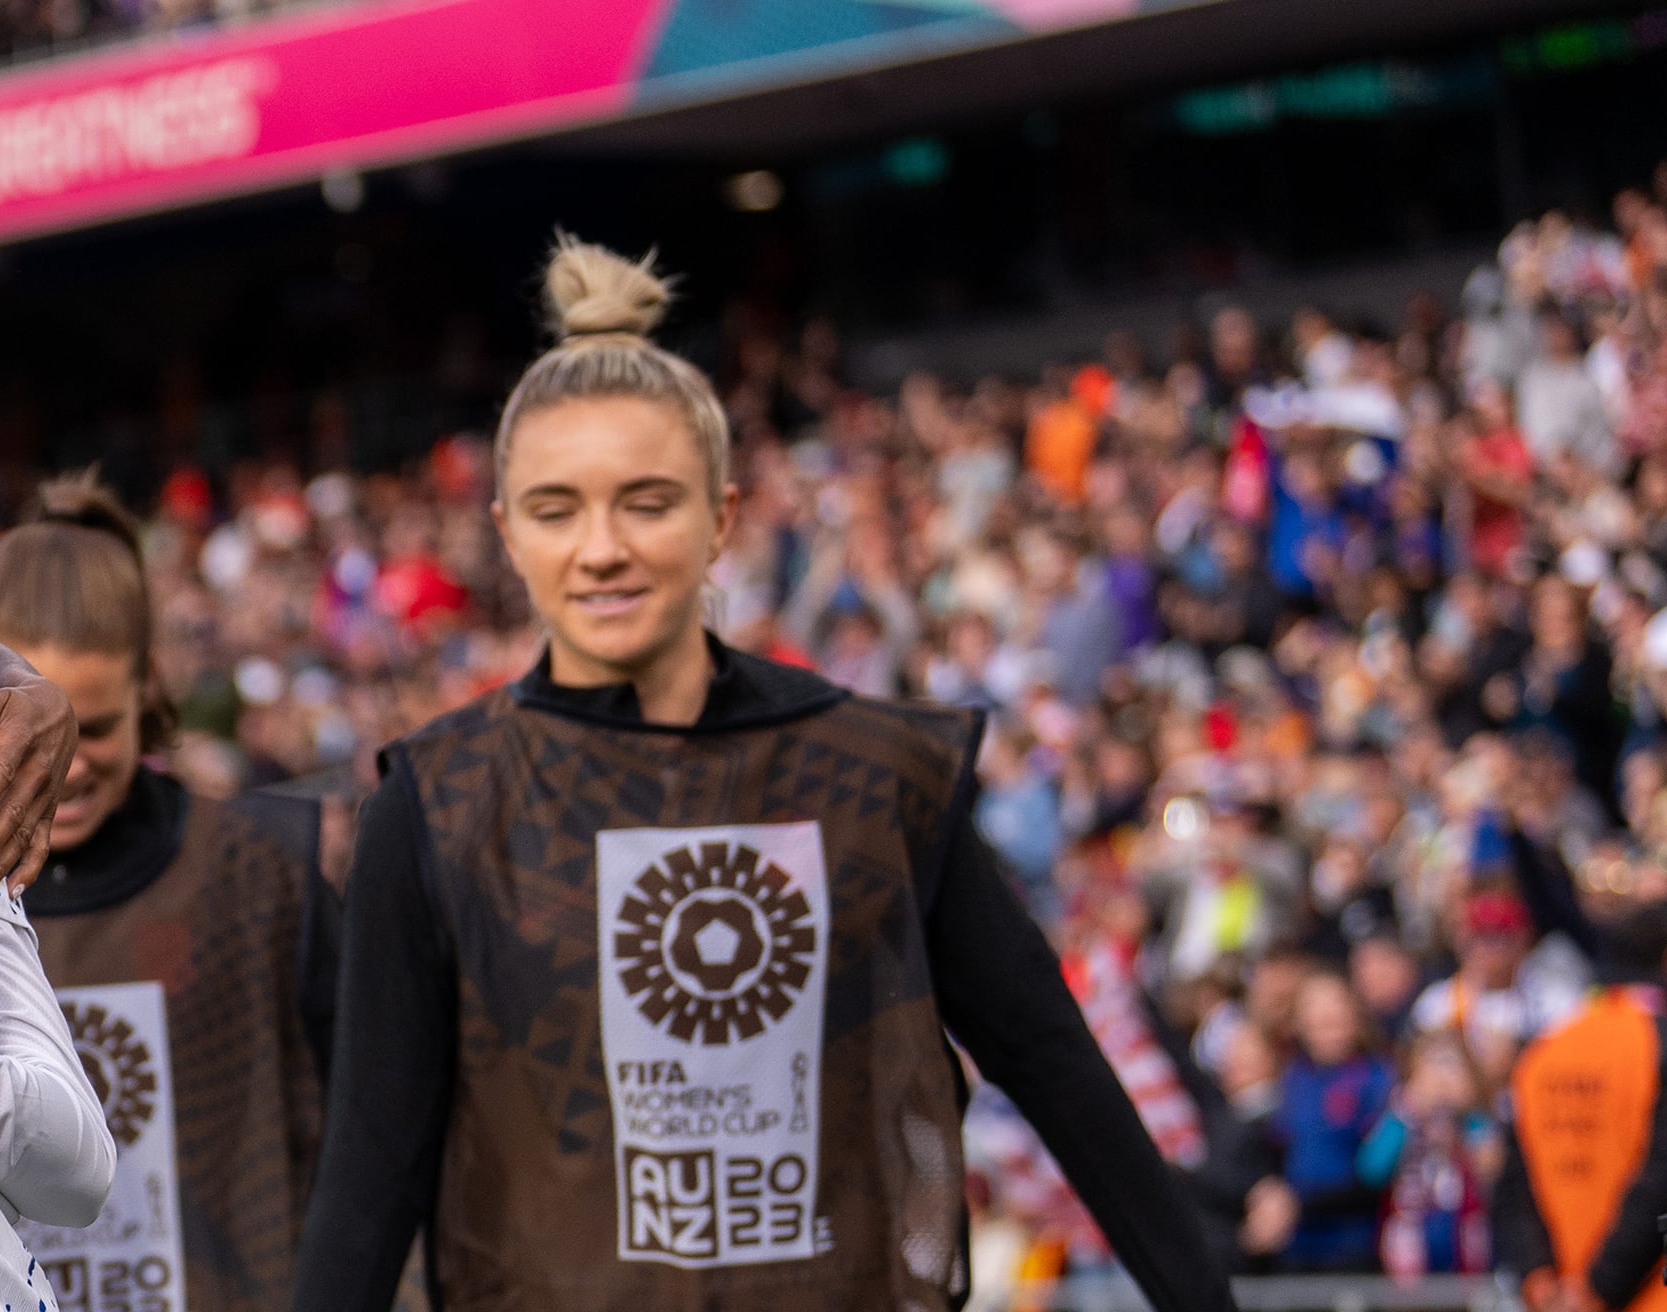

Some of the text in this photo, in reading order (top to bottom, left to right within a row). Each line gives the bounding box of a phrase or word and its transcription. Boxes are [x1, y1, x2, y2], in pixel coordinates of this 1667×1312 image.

[618, 1060, 687, 1085] FIFA
[625, 1083, 751, 1112] WOMEN'S
[628, 1109, 781, 1140] WORLD CUP
[630, 1153, 807, 1204] AU 20
[633, 1200, 803, 1252] NZ 23
[100, 1256, 171, 1296] 20
